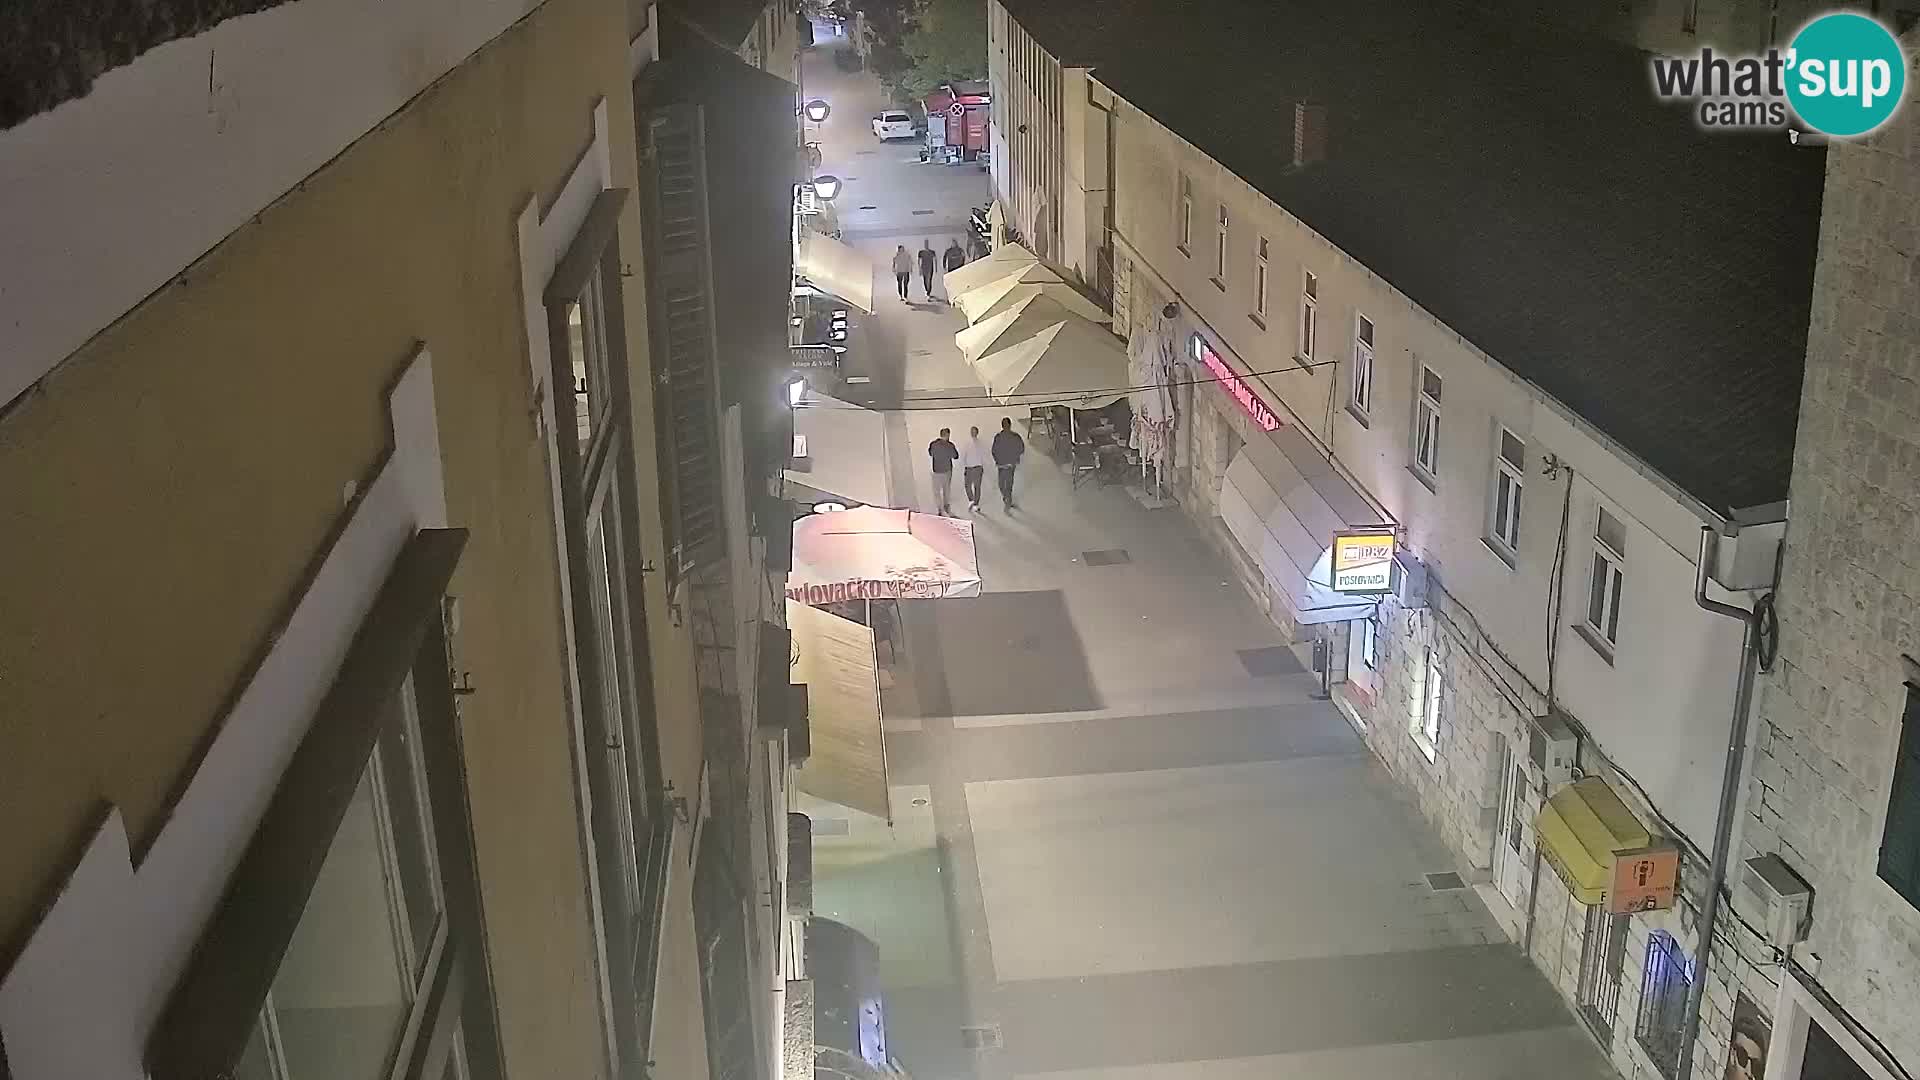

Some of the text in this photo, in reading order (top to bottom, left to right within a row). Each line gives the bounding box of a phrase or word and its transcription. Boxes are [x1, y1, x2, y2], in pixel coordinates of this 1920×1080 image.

[1360, 545, 1389, 558] PBZ
[1339, 574, 1385, 586] POSLOVNICA
[784, 576, 883, 606] arlovačko
